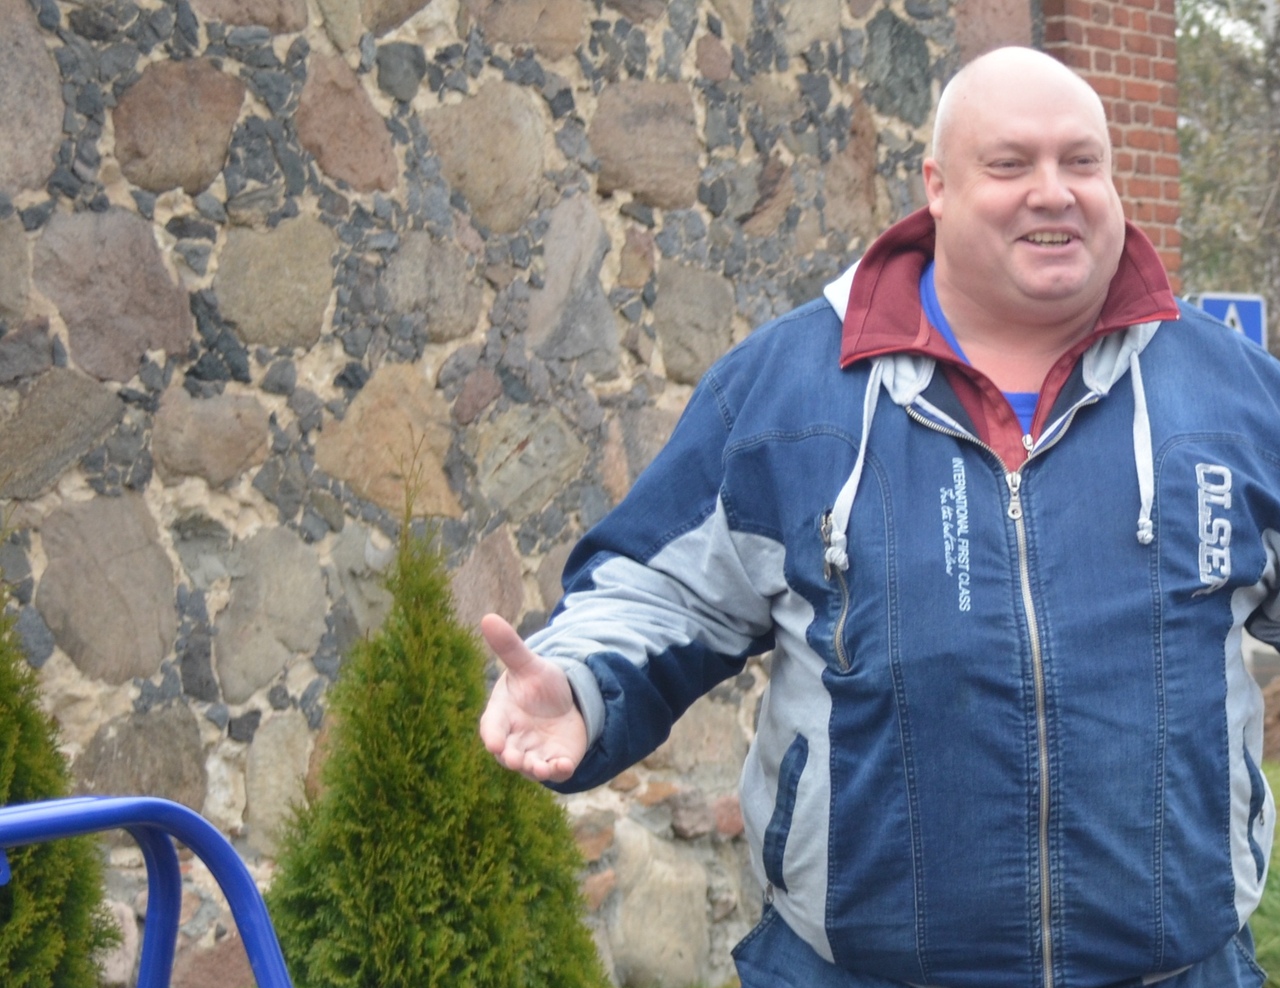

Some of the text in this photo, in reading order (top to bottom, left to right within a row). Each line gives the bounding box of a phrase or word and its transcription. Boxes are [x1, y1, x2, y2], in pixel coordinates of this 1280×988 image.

[952, 457, 971, 612] INTERNATIONAL FIRST CLASS
